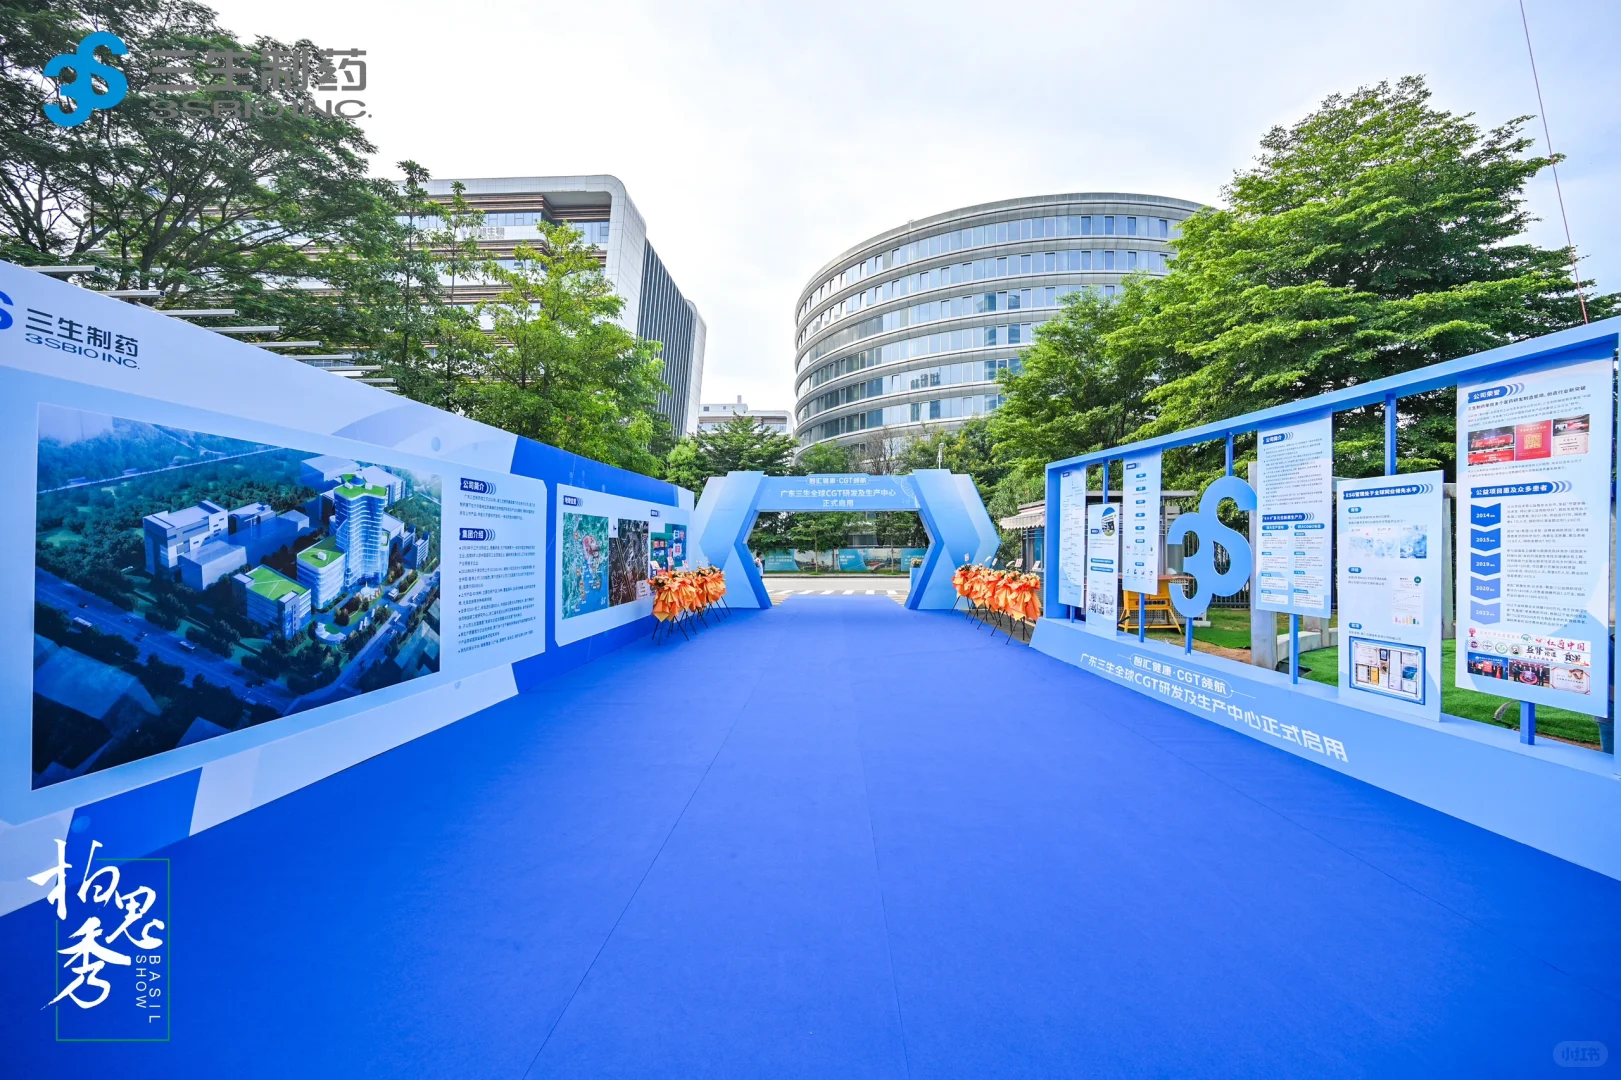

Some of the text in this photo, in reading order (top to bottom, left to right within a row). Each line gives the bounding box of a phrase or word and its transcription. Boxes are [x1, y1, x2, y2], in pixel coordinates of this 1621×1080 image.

[26, 308, 138, 358] 三生制药
[25, 332, 140, 370] 3SBIO INC.
[1473, 389, 1501, 400] 公司荣誉
[463, 480, 485, 492] 公司简介
[1476, 485, 1547, 496] 公益项目惠及众多患者
[780, 488, 897, 498] 广东三生全球CGT研发及生产中心
[1346, 486, 1418, 498] ESG管理处于全球同业领先水平
[823, 499, 854, 507] 正式启用
[461, 529, 484, 540] 集团介绍
[1080, 652, 1350, 764] 广东三生全球CGT研发及生产中心正式启用
